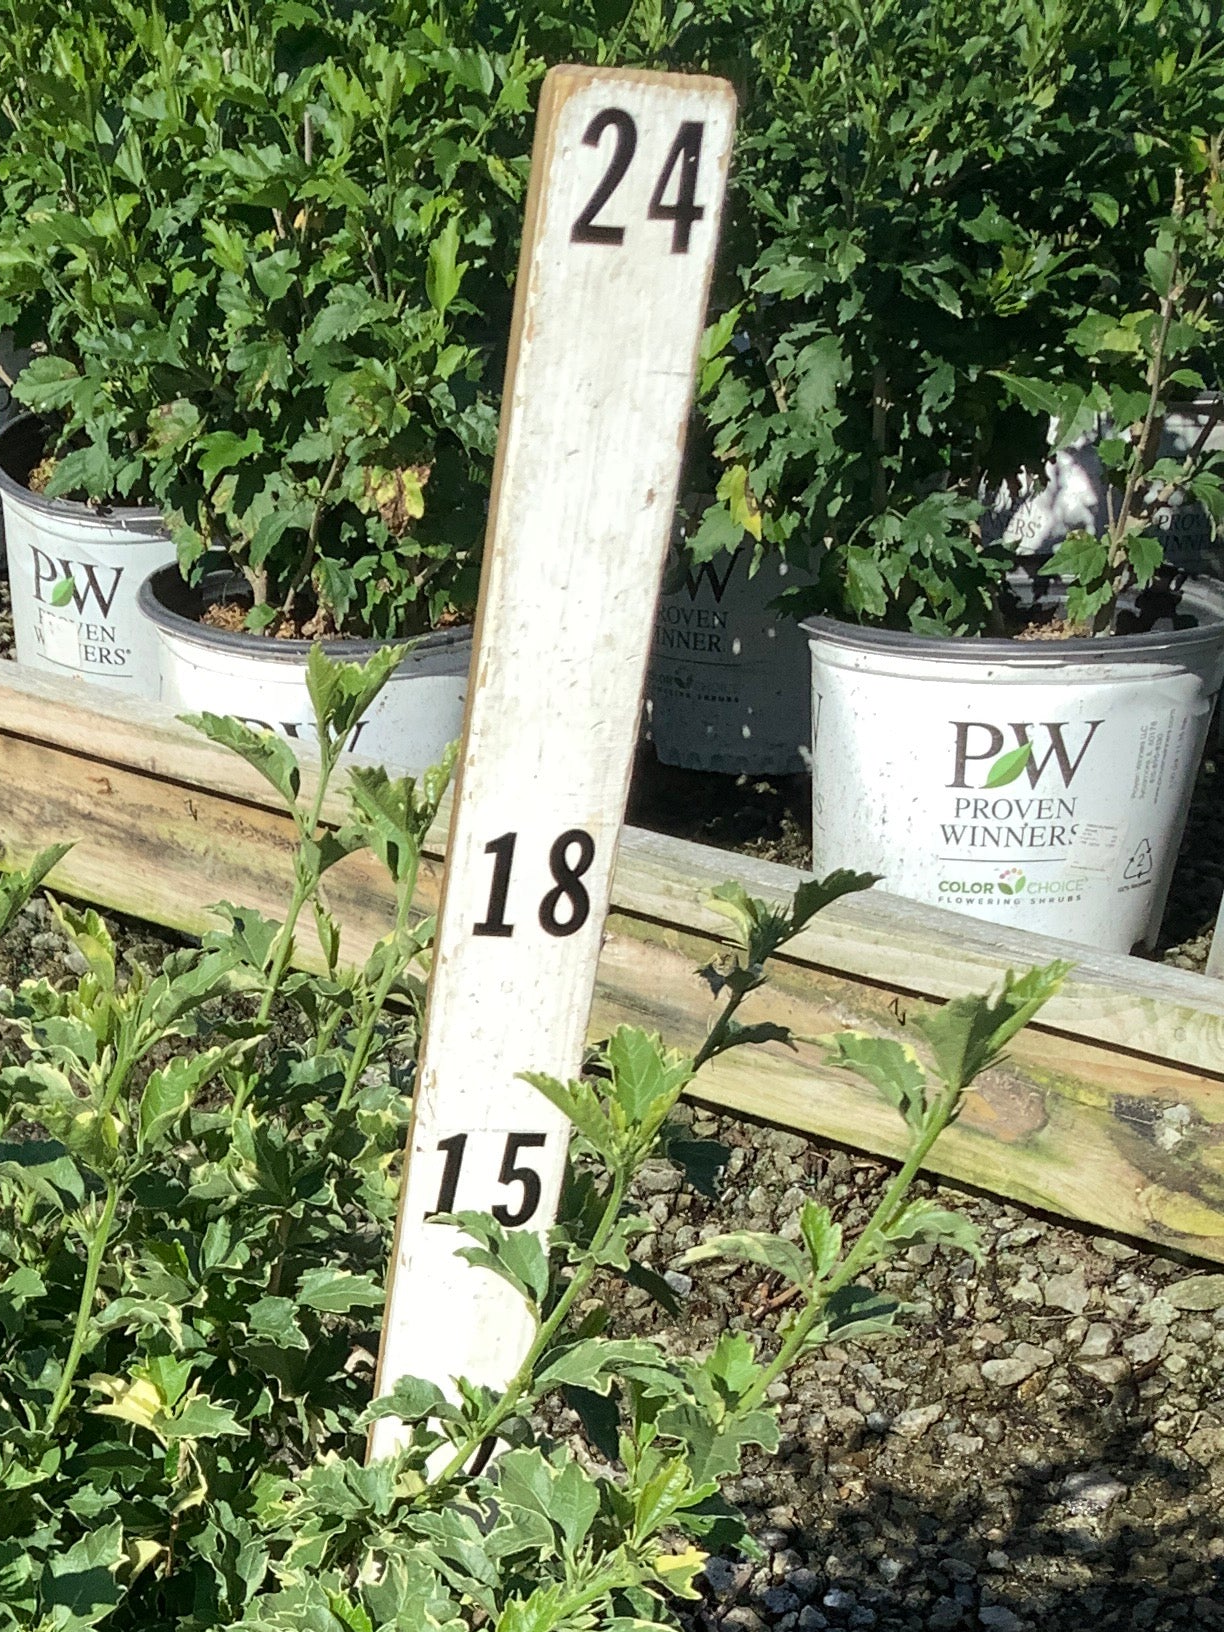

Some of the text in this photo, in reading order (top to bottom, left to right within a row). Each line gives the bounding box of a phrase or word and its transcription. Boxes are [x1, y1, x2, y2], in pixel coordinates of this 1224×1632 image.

[570, 106, 706, 255] 24
[28, 543, 125, 620] PW
[655, 624, 722, 653] INNER
[658, 604, 728, 630] ROVEN
[945, 719, 1106, 791] PW
[954, 797, 1079, 821] PROVEN
[472, 828, 596, 938] 18
[937, 894, 1082, 906] FLOWERING SHRUBS
[938, 879, 1085, 895] COLOR CHOICE
[422, 1132, 548, 1228] 15
